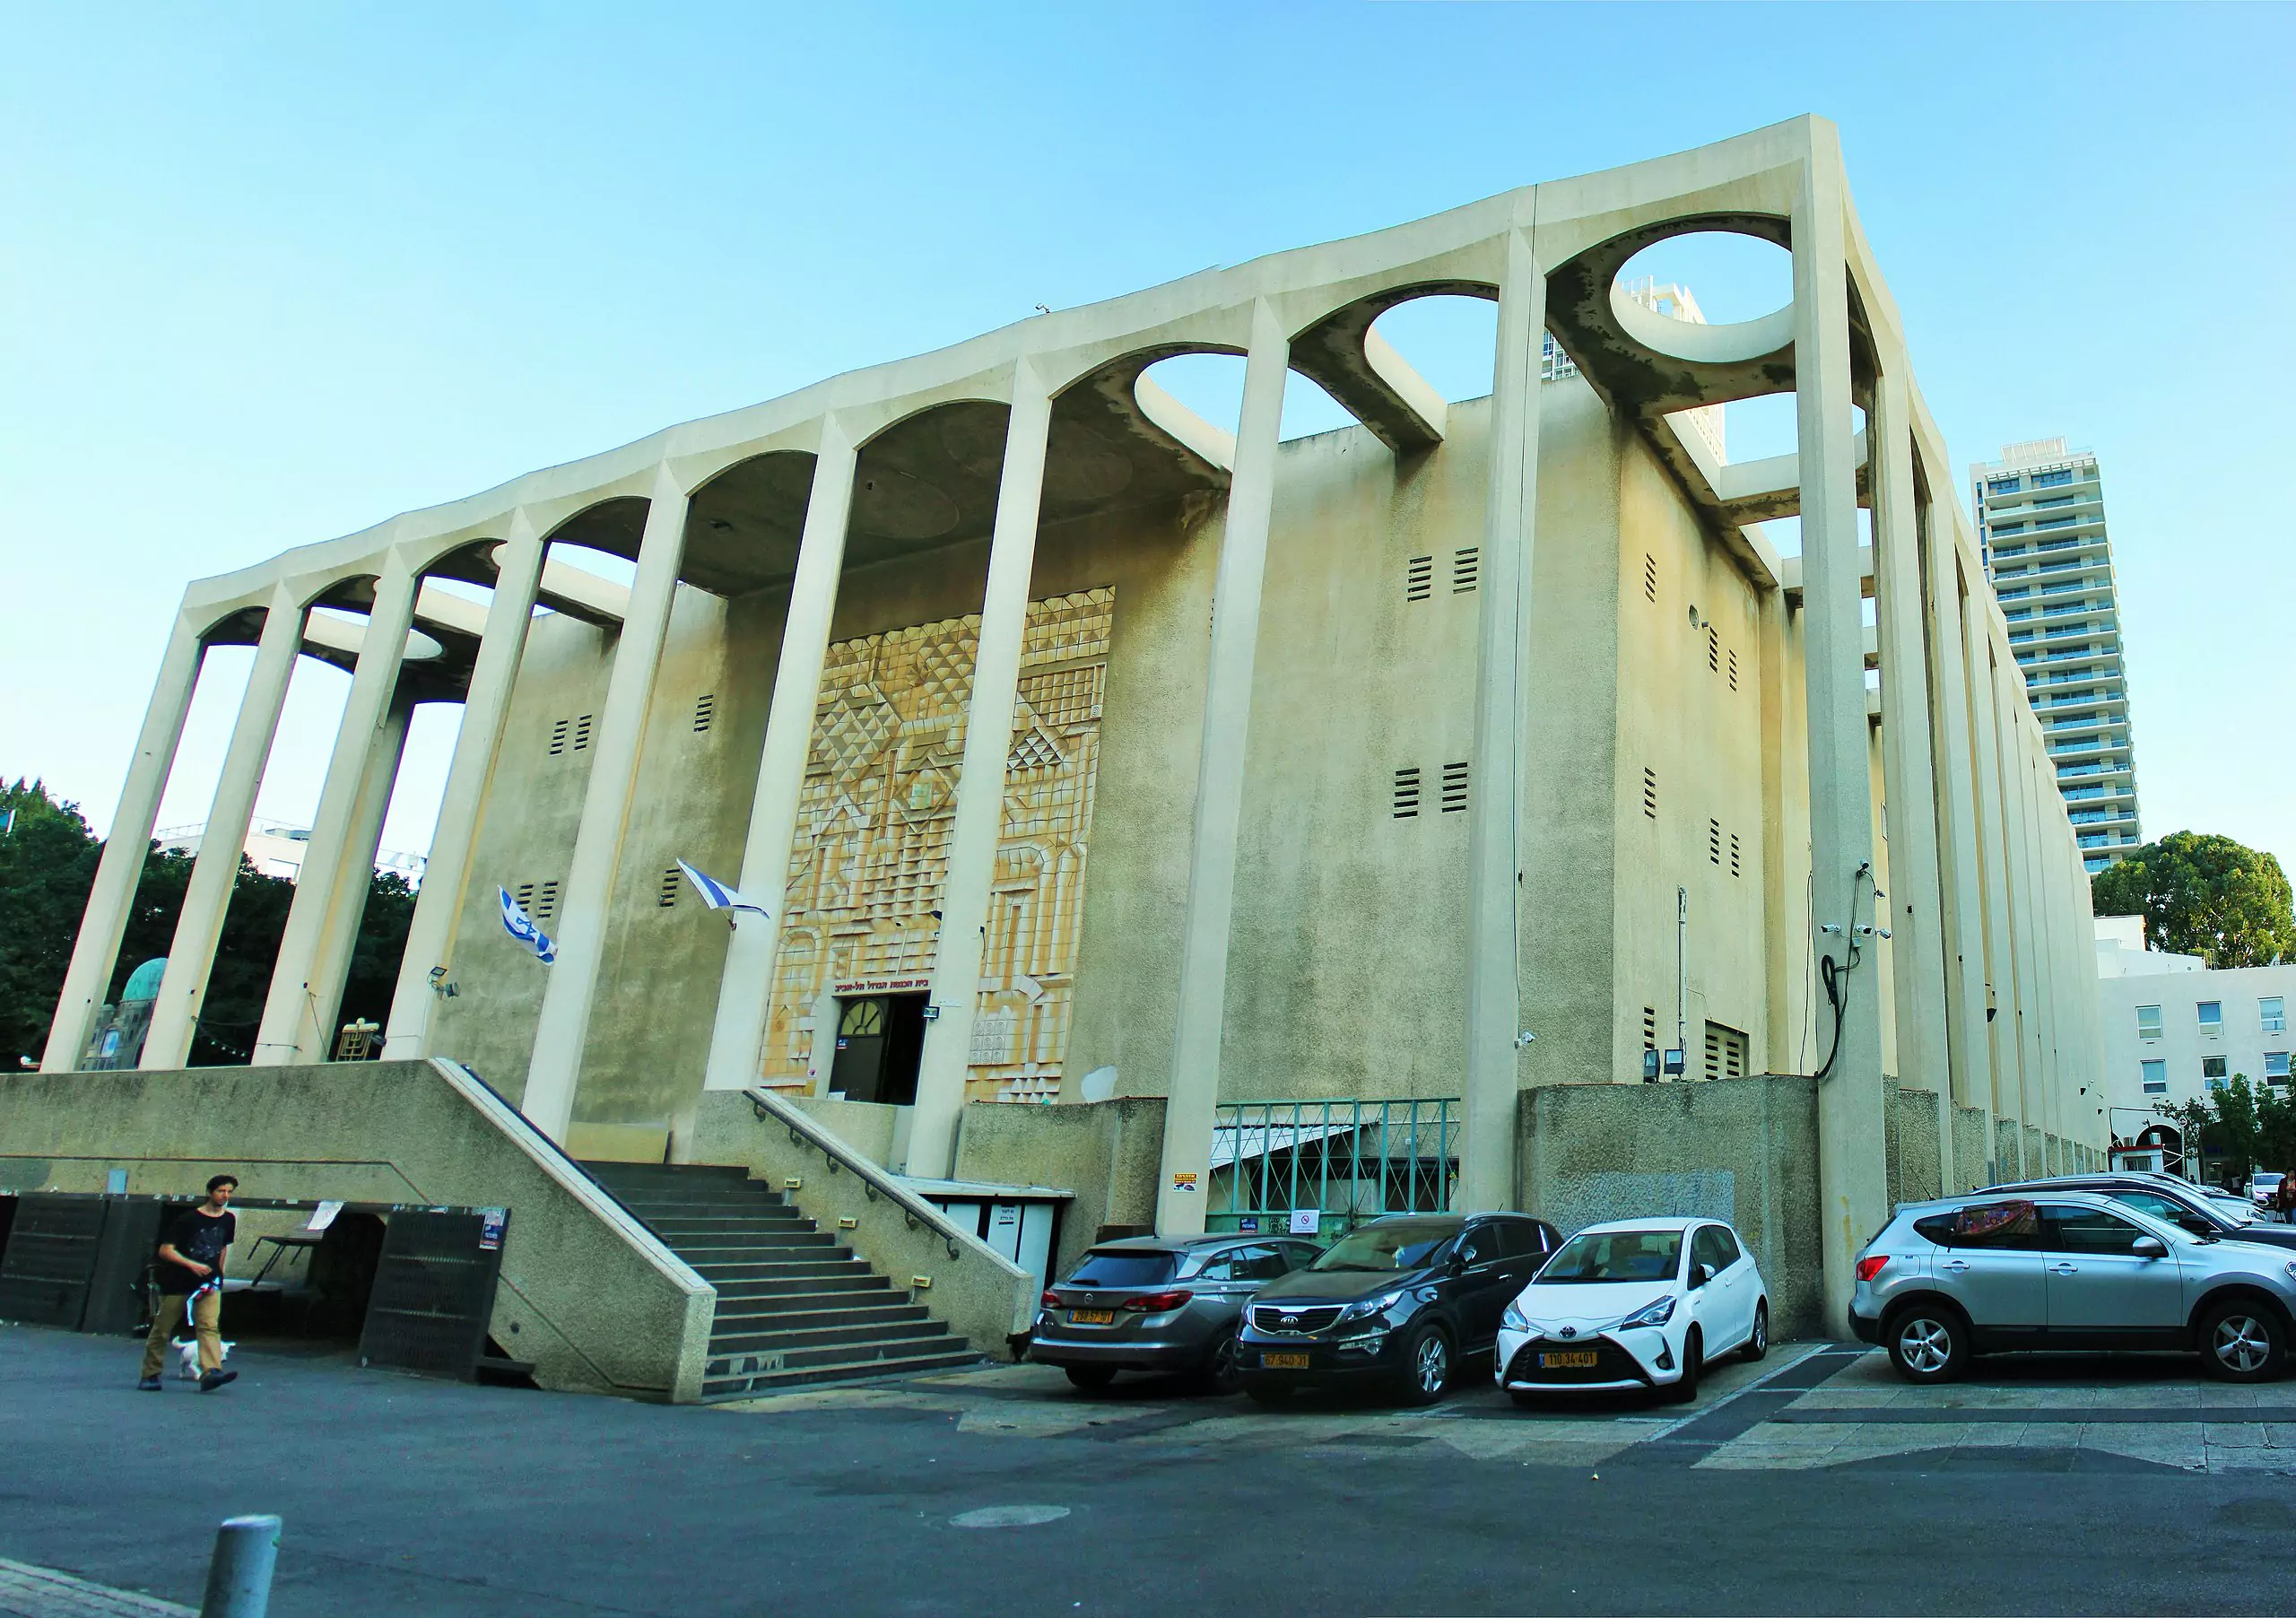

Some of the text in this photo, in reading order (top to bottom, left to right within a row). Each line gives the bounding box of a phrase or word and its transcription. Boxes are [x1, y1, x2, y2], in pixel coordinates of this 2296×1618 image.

[866, 980, 888, 990] הגדול
[890, 980, 913, 988] הכנסת
[915, 979, 928, 987] בית
